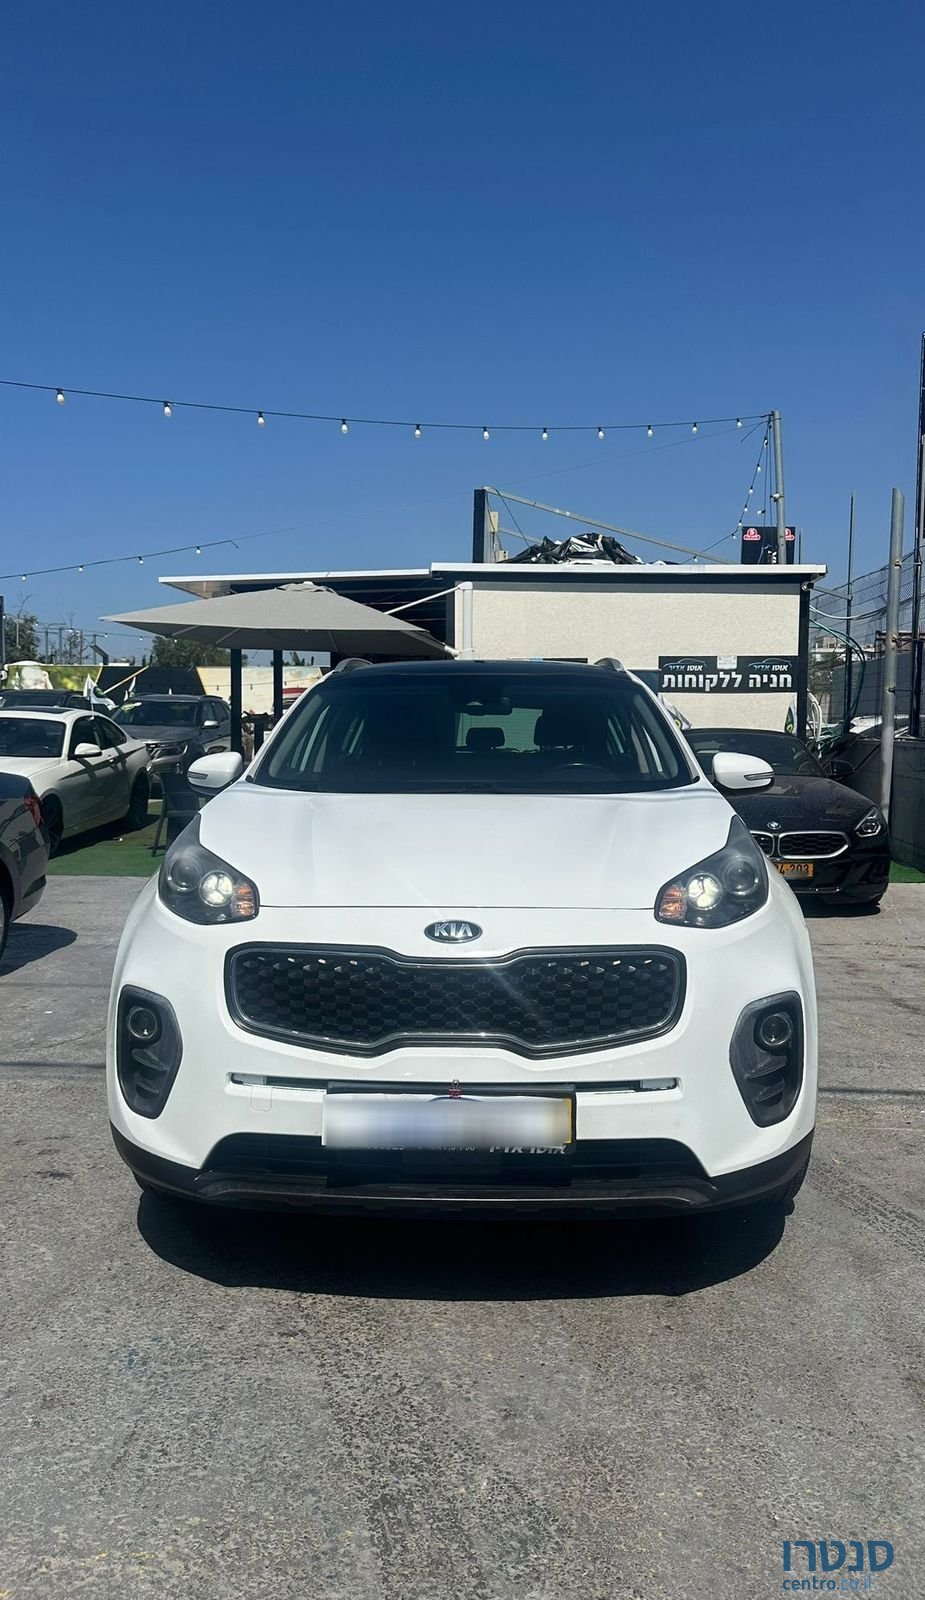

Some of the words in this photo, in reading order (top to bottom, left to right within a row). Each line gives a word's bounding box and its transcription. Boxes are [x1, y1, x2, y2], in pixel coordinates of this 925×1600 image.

[662, 671, 742, 691] ללקוחות
[748, 673, 792, 688] חניה
[434, 922, 473, 937] KIA
